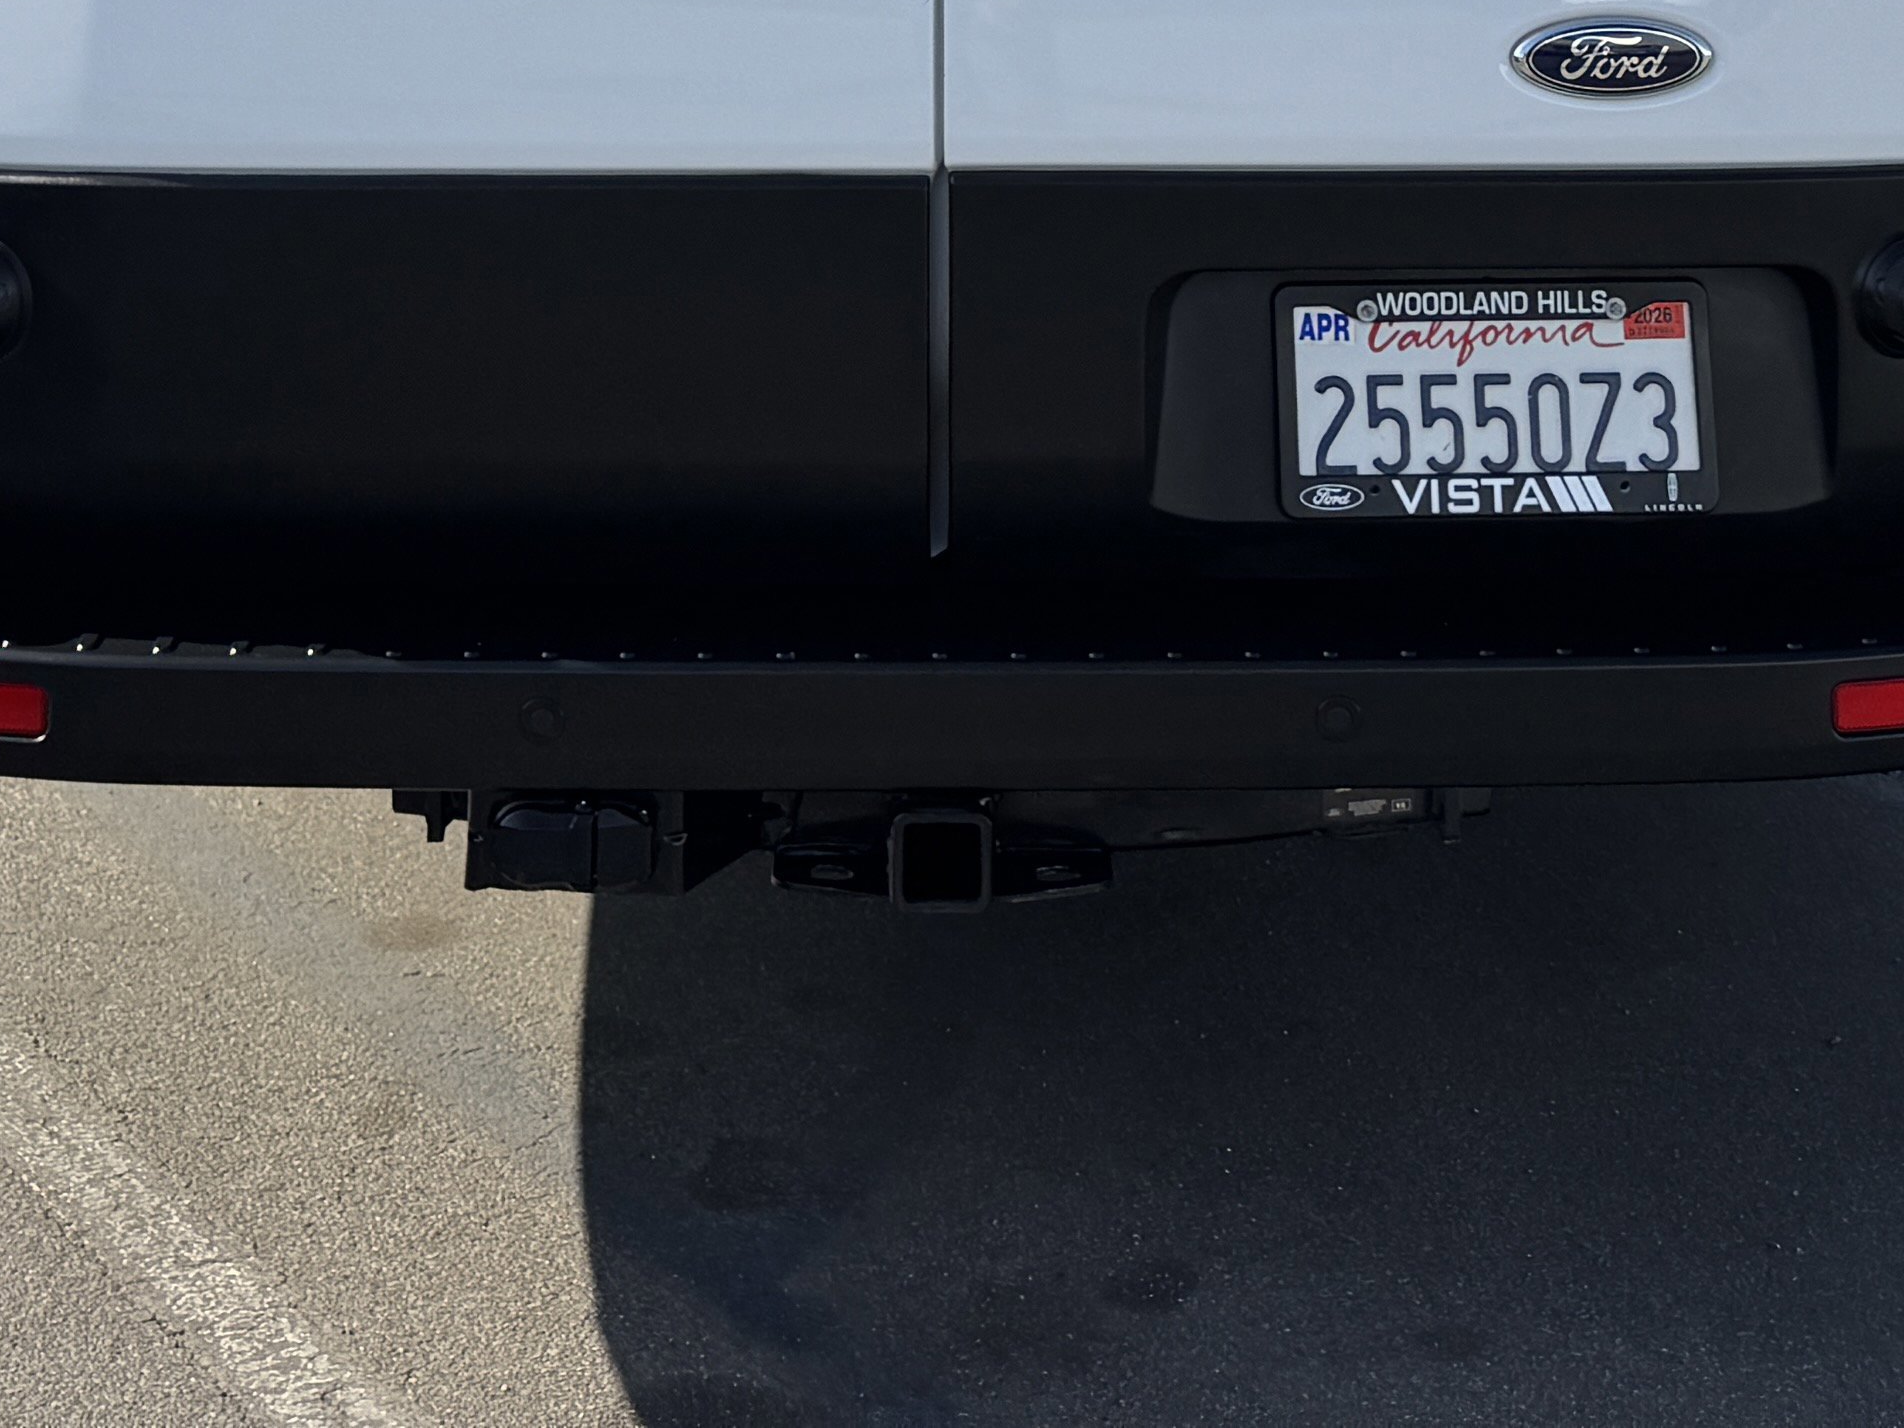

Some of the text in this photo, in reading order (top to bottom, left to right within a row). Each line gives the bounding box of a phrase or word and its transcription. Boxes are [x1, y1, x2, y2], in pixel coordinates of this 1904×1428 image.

[1377, 290, 1607, 315] WOODLAND HILLS
[1634, 307, 1673, 324] 2026
[1299, 313, 1350, 341] APR
[1368, 322, 1625, 367] California
[1314, 372, 1679, 475] 25550Z3
[1391, 477, 1552, 515] VISTA
[1644, 503, 1703, 513] LINCOLN
